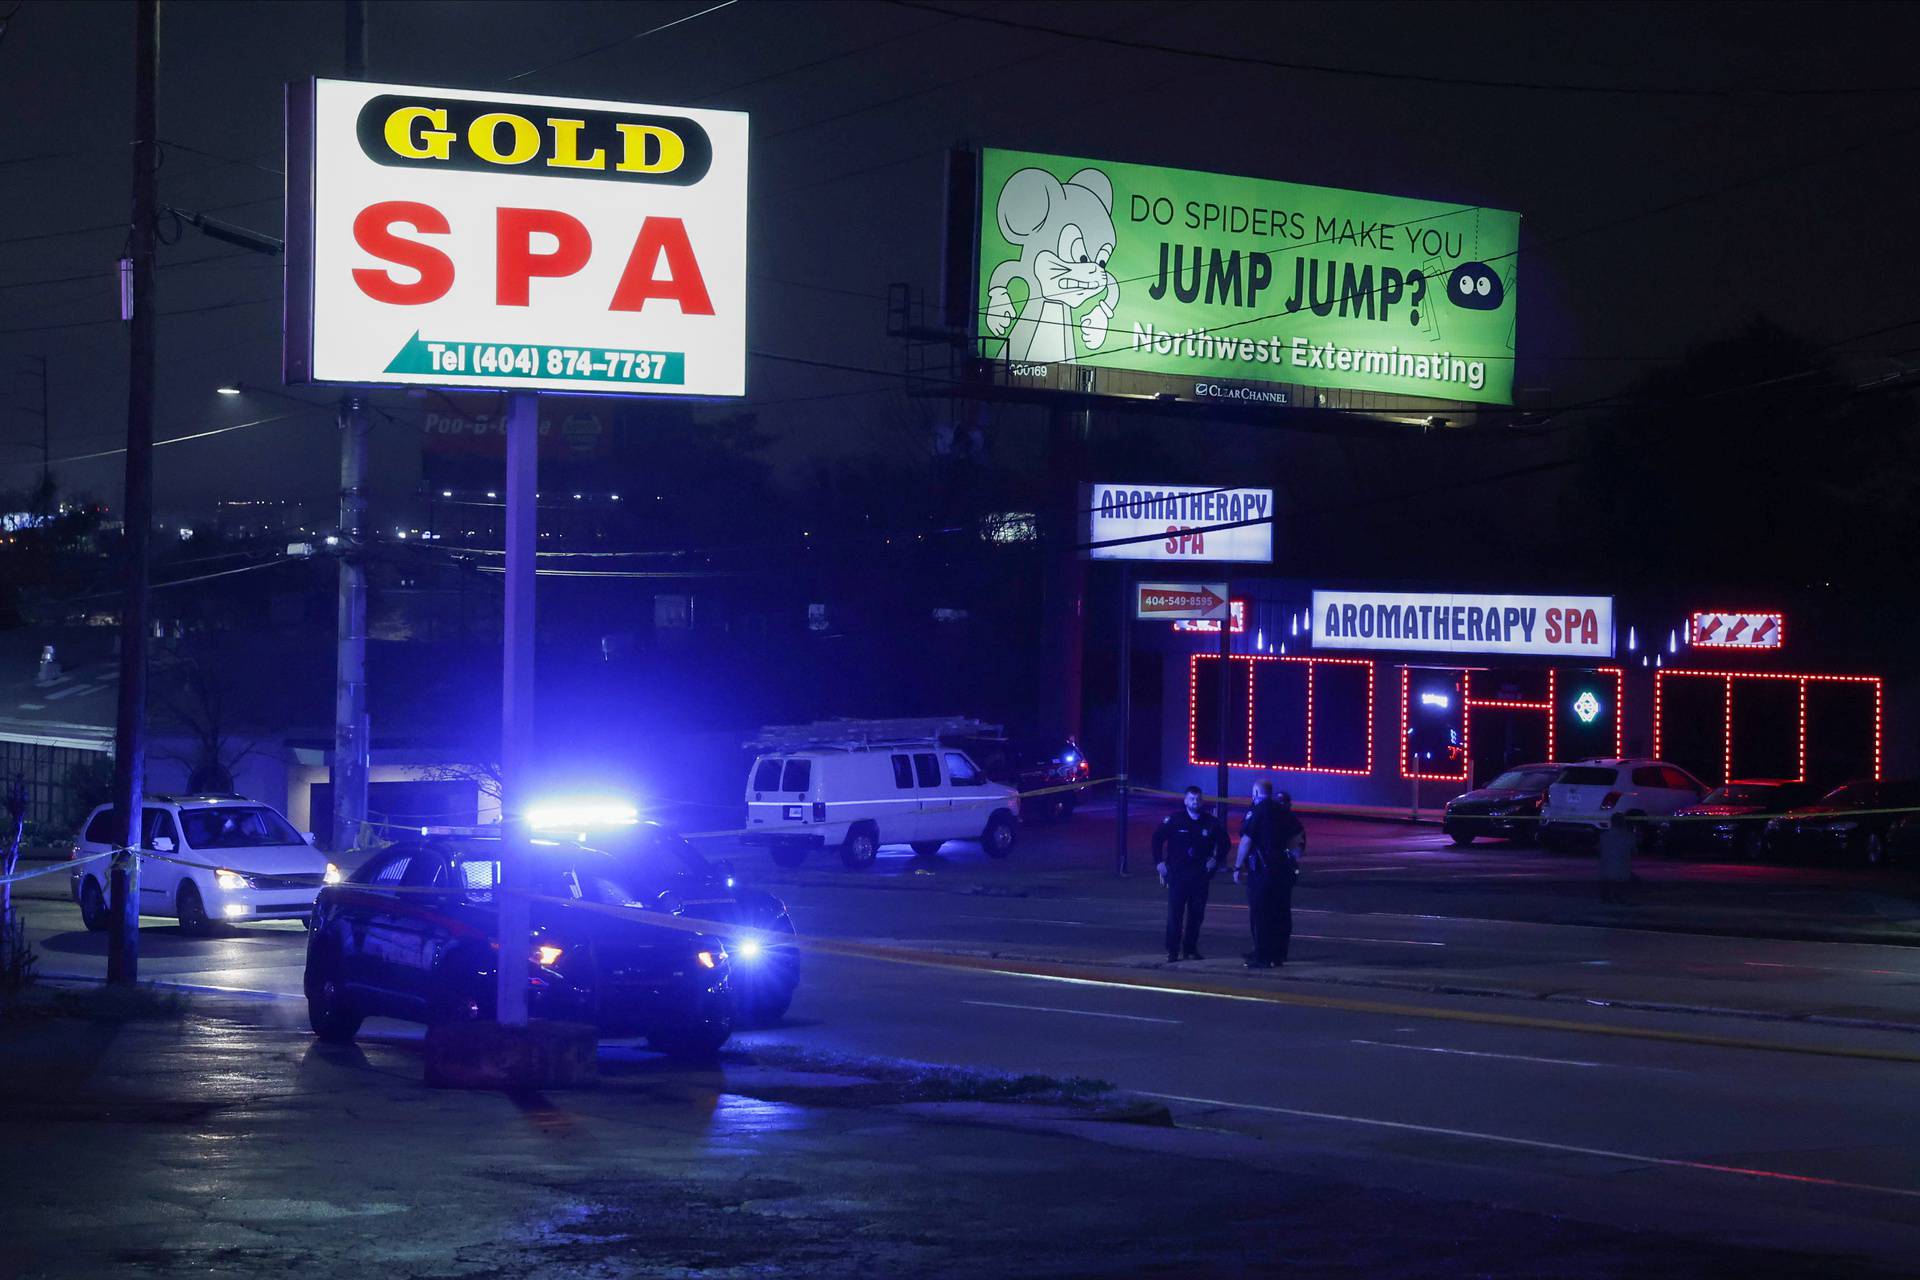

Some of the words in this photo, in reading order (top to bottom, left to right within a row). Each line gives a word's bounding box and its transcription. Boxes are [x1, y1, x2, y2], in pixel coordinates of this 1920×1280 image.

[384, 108, 685, 174] GOLD
[352, 200, 716, 316] SPA
[1131, 194, 1174, 226] DO
[1184, 201, 1306, 240] SPIDERS
[1315, 215, 1396, 251] MAKE
[1405, 226, 1463, 259] YOU
[1148, 242, 1273, 308] JUMP
[1285, 256, 1427, 327] JUMP?
[428, 344, 465, 371] Tel
[472, 344, 539, 376] (404)
[546, 349, 667, 380] 874-7737
[1133, 321, 1282, 364] Northwest
[1291, 336, 1486, 390] Exterminating
[1100, 489, 1268, 522] AROMATHERAPY
[1165, 525, 1204, 555] SPA
[1325, 603, 1537, 643] AROMATHERAPY
[1545, 607, 1599, 645] SPA
